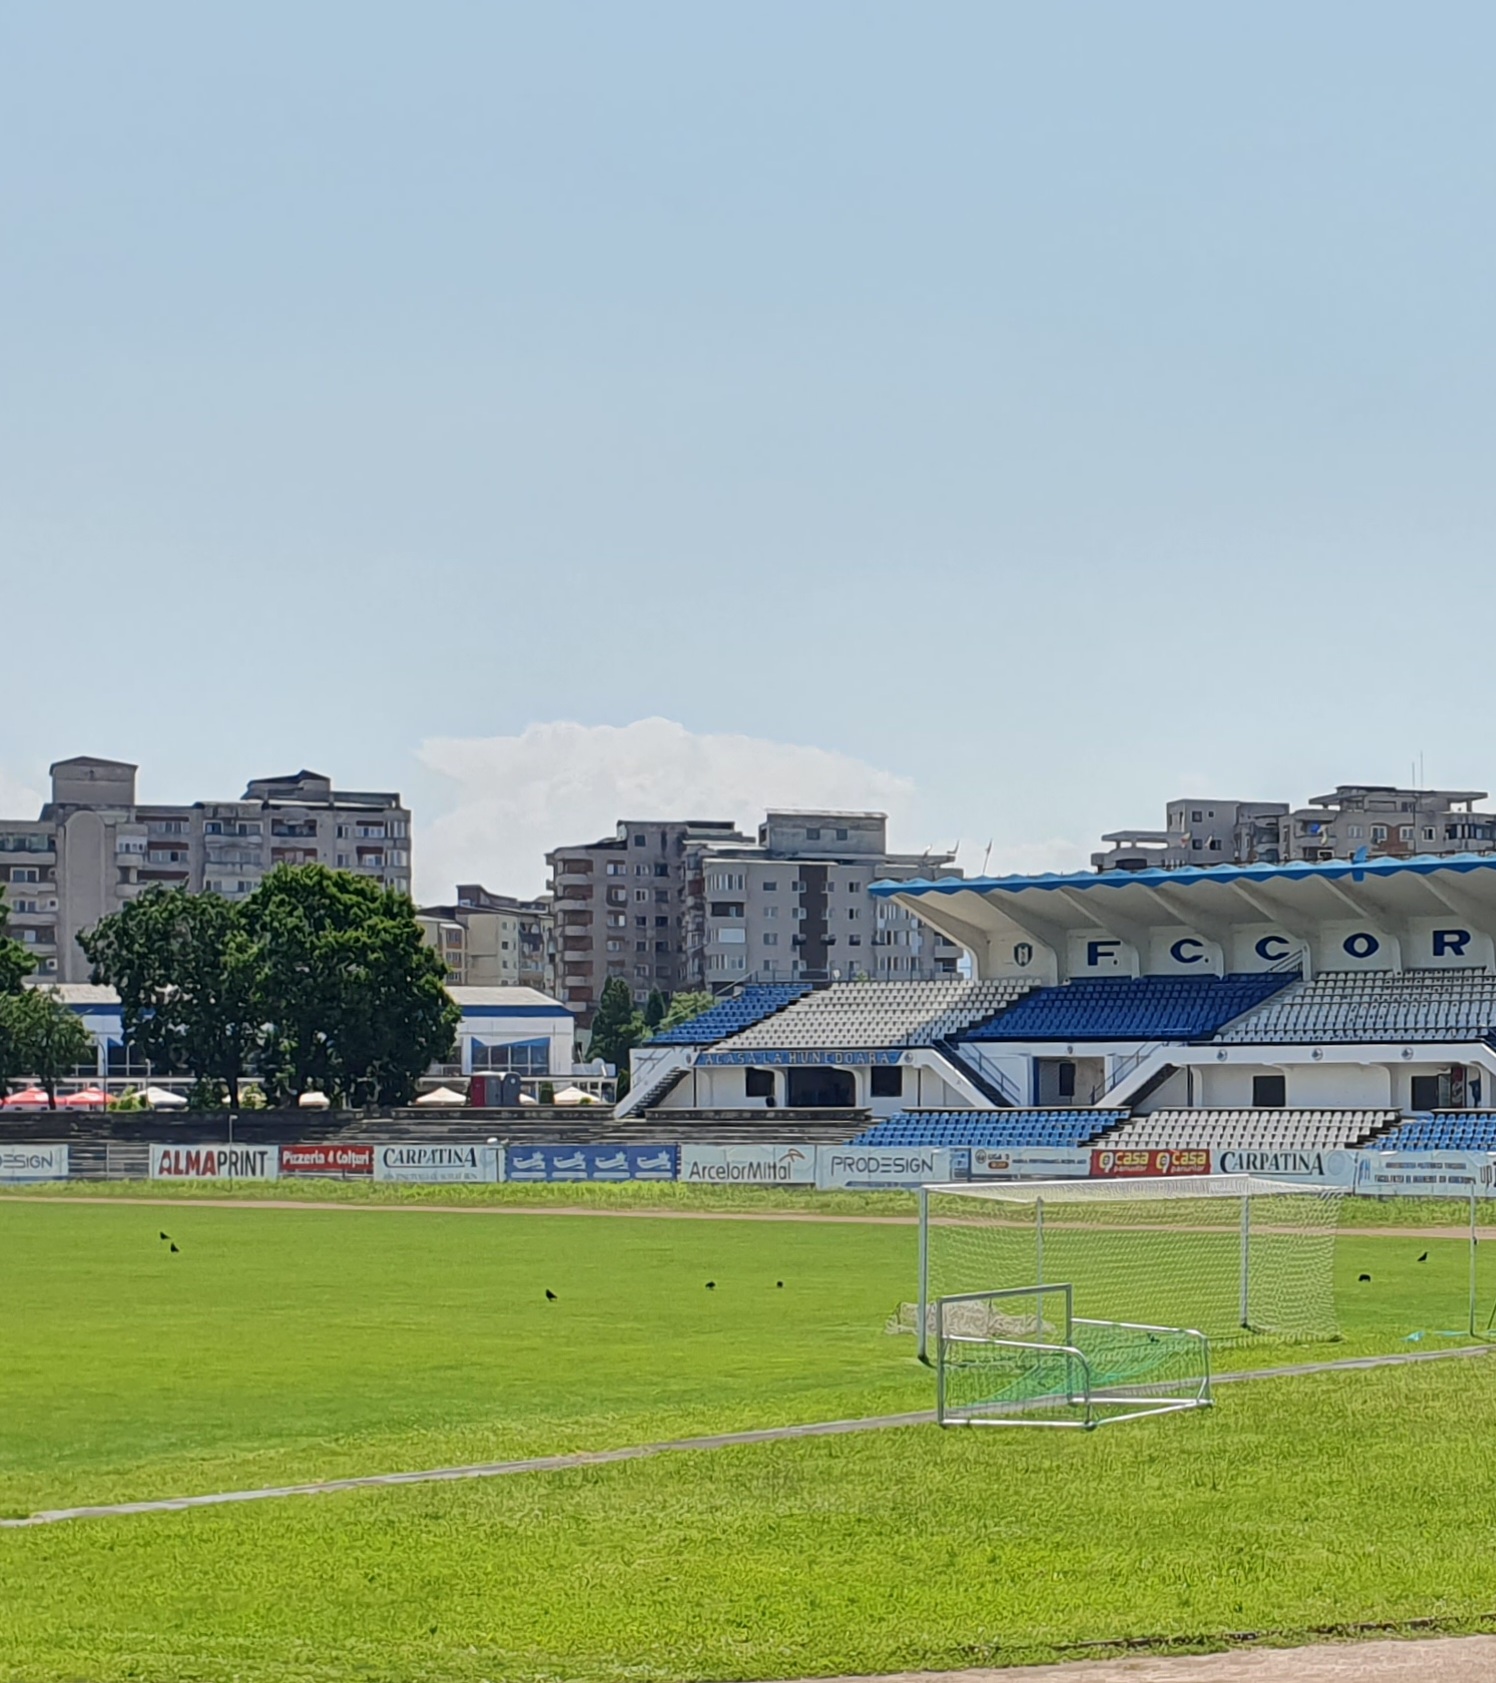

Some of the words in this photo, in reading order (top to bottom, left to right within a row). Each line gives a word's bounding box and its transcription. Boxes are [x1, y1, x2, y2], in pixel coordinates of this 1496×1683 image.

[763, 1051, 783, 1064] LA
[788, 1050, 890, 1065] HUNEDOARA
[0, 1150, 53, 1169] ESIGN
[158, 1149, 269, 1177] ALMAPRINT
[282, 1150, 325, 1165] Pizzeria
[327, 1150, 334, 1164] 4
[383, 1147, 478, 1168] CARPATINA
[831, 1153, 934, 1176] PRODESIGN
[1115, 1152, 1149, 1165] casa
[1172, 1151, 1207, 1165] casa
[1220, 1151, 1325, 1176] CARPATINA
[688, 1160, 792, 1181] ArcelorMittal
